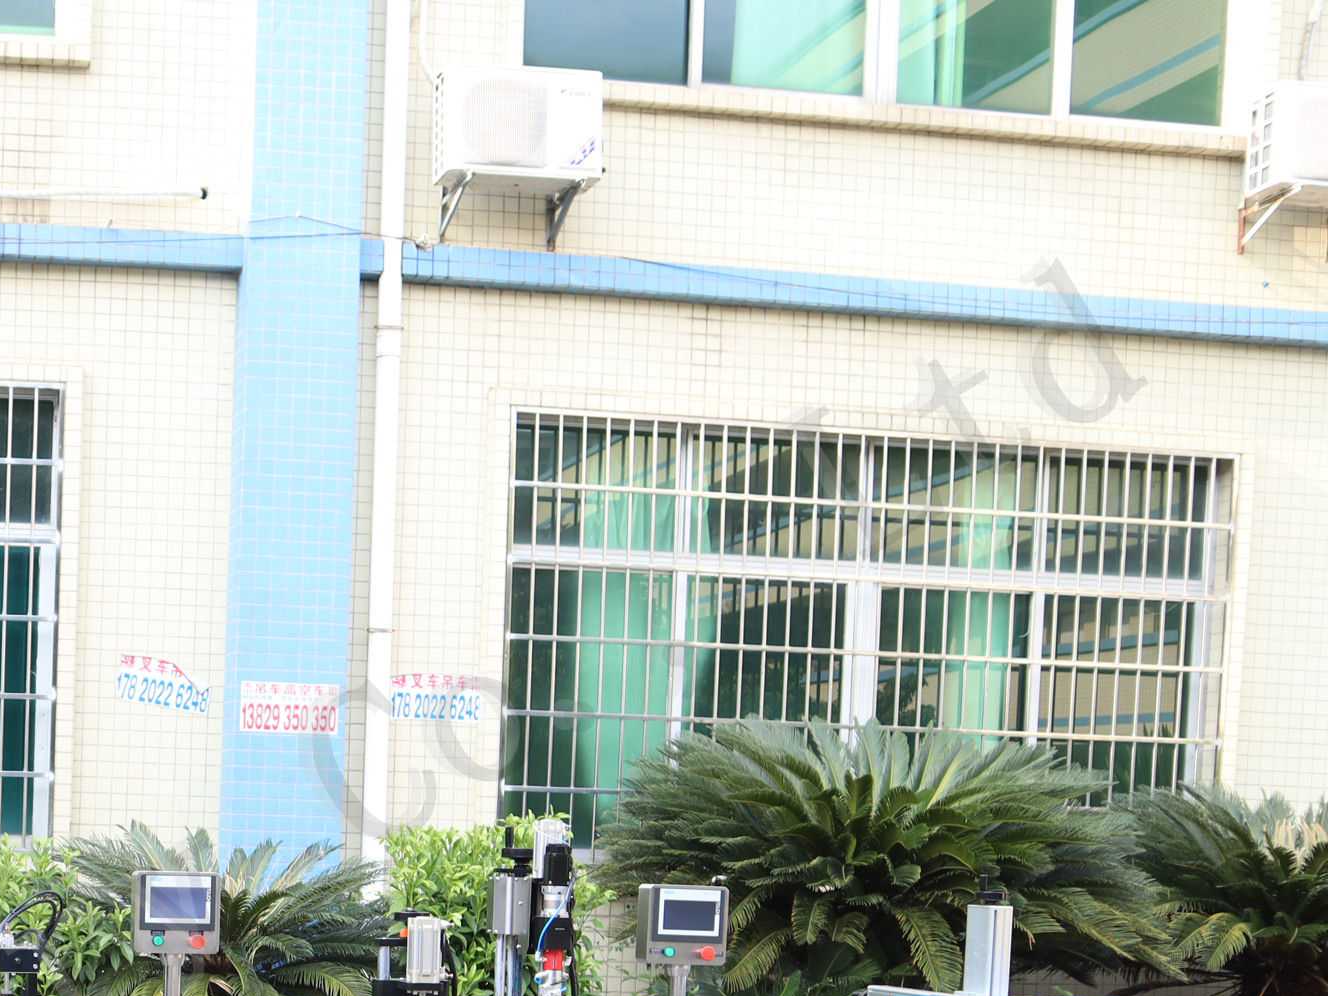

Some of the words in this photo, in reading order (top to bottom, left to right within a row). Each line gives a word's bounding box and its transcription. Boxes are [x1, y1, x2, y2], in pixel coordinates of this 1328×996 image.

[138, 677, 174, 707] 2022
[391, 691, 411, 718] 178
[414, 693, 447, 719] 2022
[241, 703, 280, 730] 13829
[283, 704, 309, 731] 350
